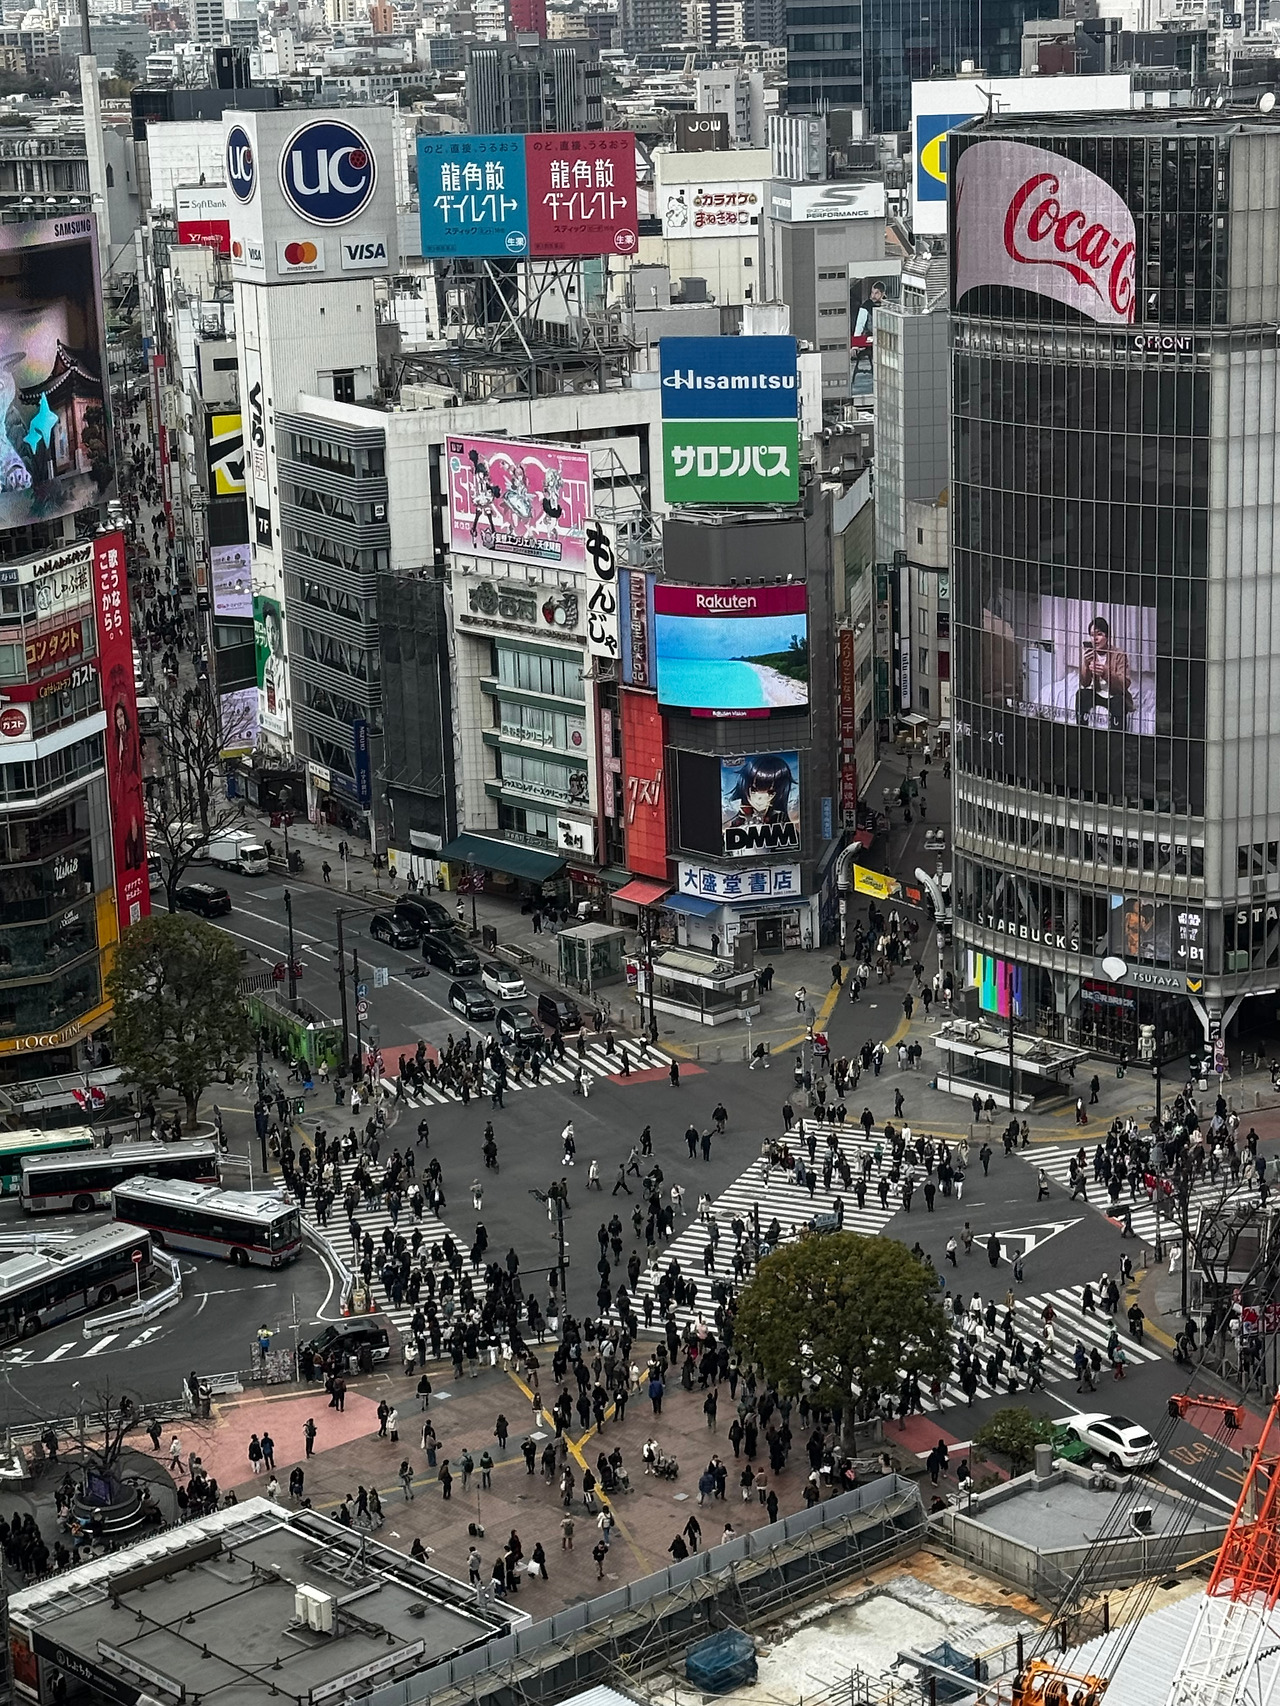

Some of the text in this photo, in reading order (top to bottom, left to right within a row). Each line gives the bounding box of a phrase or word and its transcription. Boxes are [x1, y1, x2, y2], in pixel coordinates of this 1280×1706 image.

[688, 120, 721, 132] JOW
[441, 161, 505, 191] 龍角散
[550, 159, 615, 189] 龍角散
[191, 199, 227, 209] SoftBank
[433, 194, 518, 223] ダイレクト
[542, 192, 628, 221] ダイレクト
[702, 193, 749, 207] カラオケ
[694, 210, 750, 227] まねきねこ
[806, 211, 869, 219] PERFORMANCE
[54, 218, 91, 237] SAMSUNG
[248, 247, 262, 261] VISA
[344, 243, 386, 260] VISA
[1134, 335, 1192, 351] QFRONT
[662, 369, 795, 390] Hisamitsu
[671, 445, 791, 477] サロンパス
[258, 517, 269, 534] 7F
[99, 552, 115, 641] ここから。
[108, 548, 124, 637] 歌うなら、
[585, 521, 619, 656] もんじゃ
[696, 594, 757, 608] Rakuten
[26, 627, 79, 665] コンタクト
[71, 663, 97, 690] ガスト
[2, 722, 25, 730] ガスト
[627, 769, 664, 824] クスリ
[725, 823, 798, 851] DMM
[684, 869, 793, 894] 大盛堂書店
[978, 912, 1079, 951] STARBUCKS
[1190, 946, 1204, 961] B1
[1133, 972, 1180, 988] TSUTAYA
